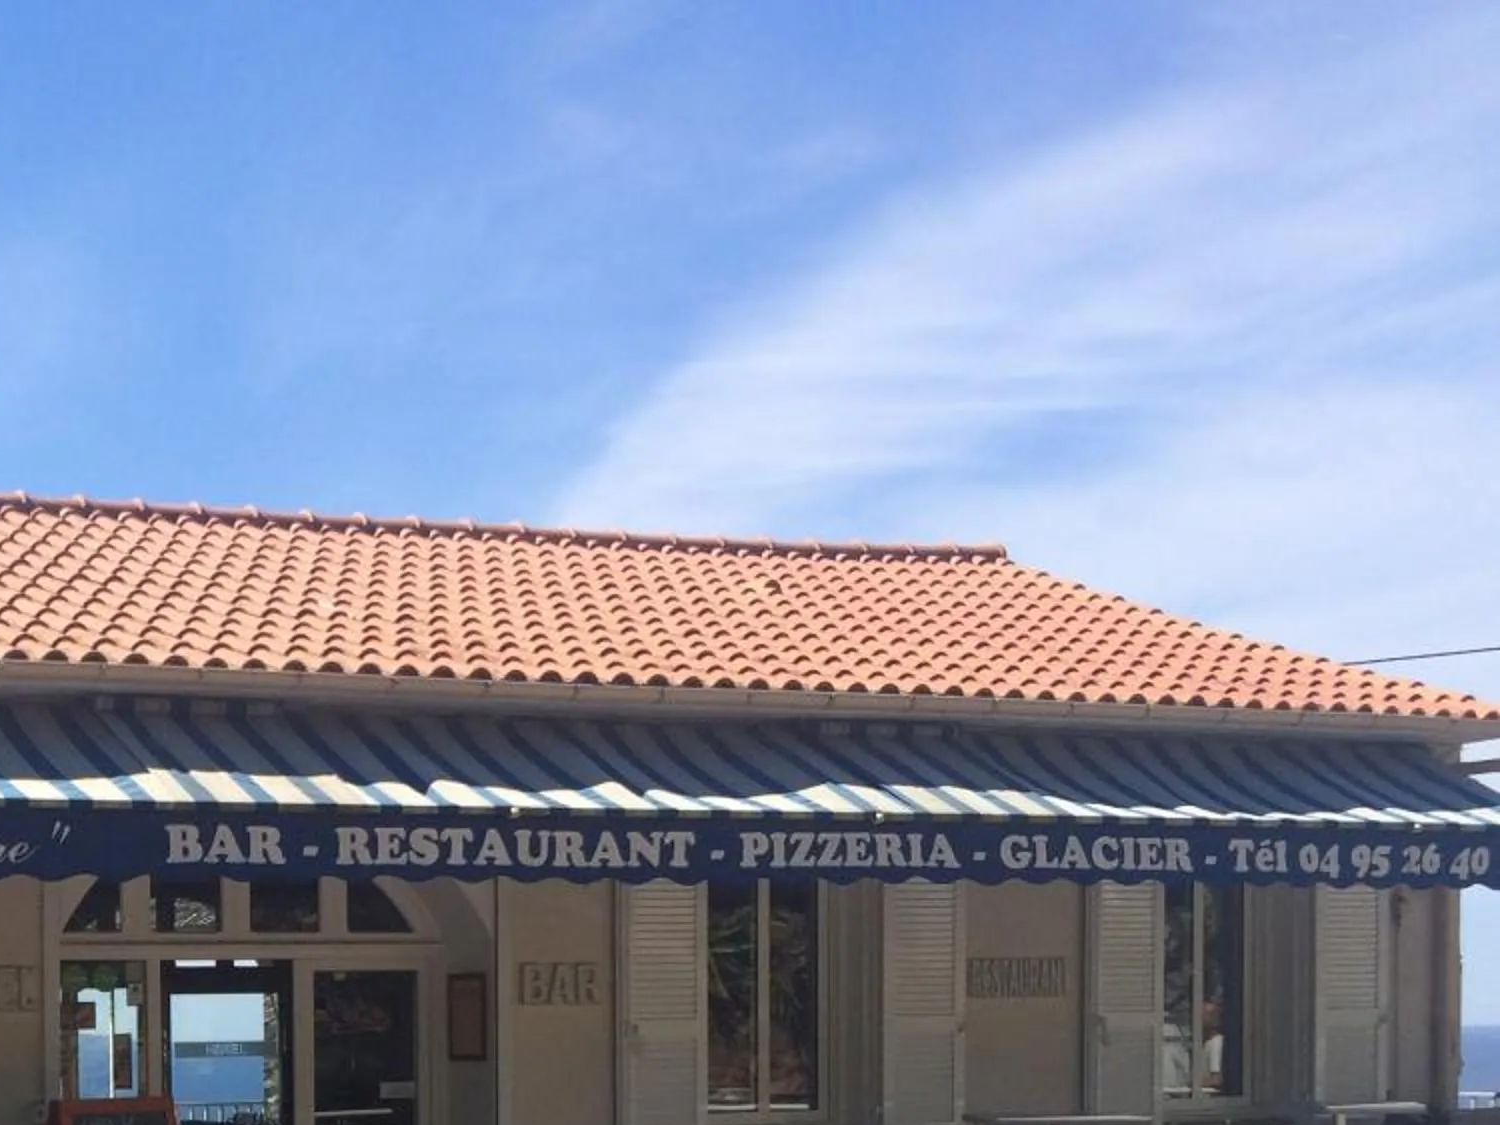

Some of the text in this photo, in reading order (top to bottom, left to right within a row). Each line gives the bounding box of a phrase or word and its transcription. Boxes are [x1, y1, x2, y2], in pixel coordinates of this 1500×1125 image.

[165, 824, 288, 865] BAR
[336, 826, 696, 868] RESTAURANT
[739, 831, 961, 869] PIZZERIA
[1000, 834, 1194, 871] GLACIER
[1227, 838, 1288, 873] Tél
[1298, 843, 1340, 879] 04
[1351, 844, 1393, 879] 95
[1401, 843, 1441, 875] 26
[1449, 846, 1490, 880] 40
[518, 962, 601, 1006] BAR
